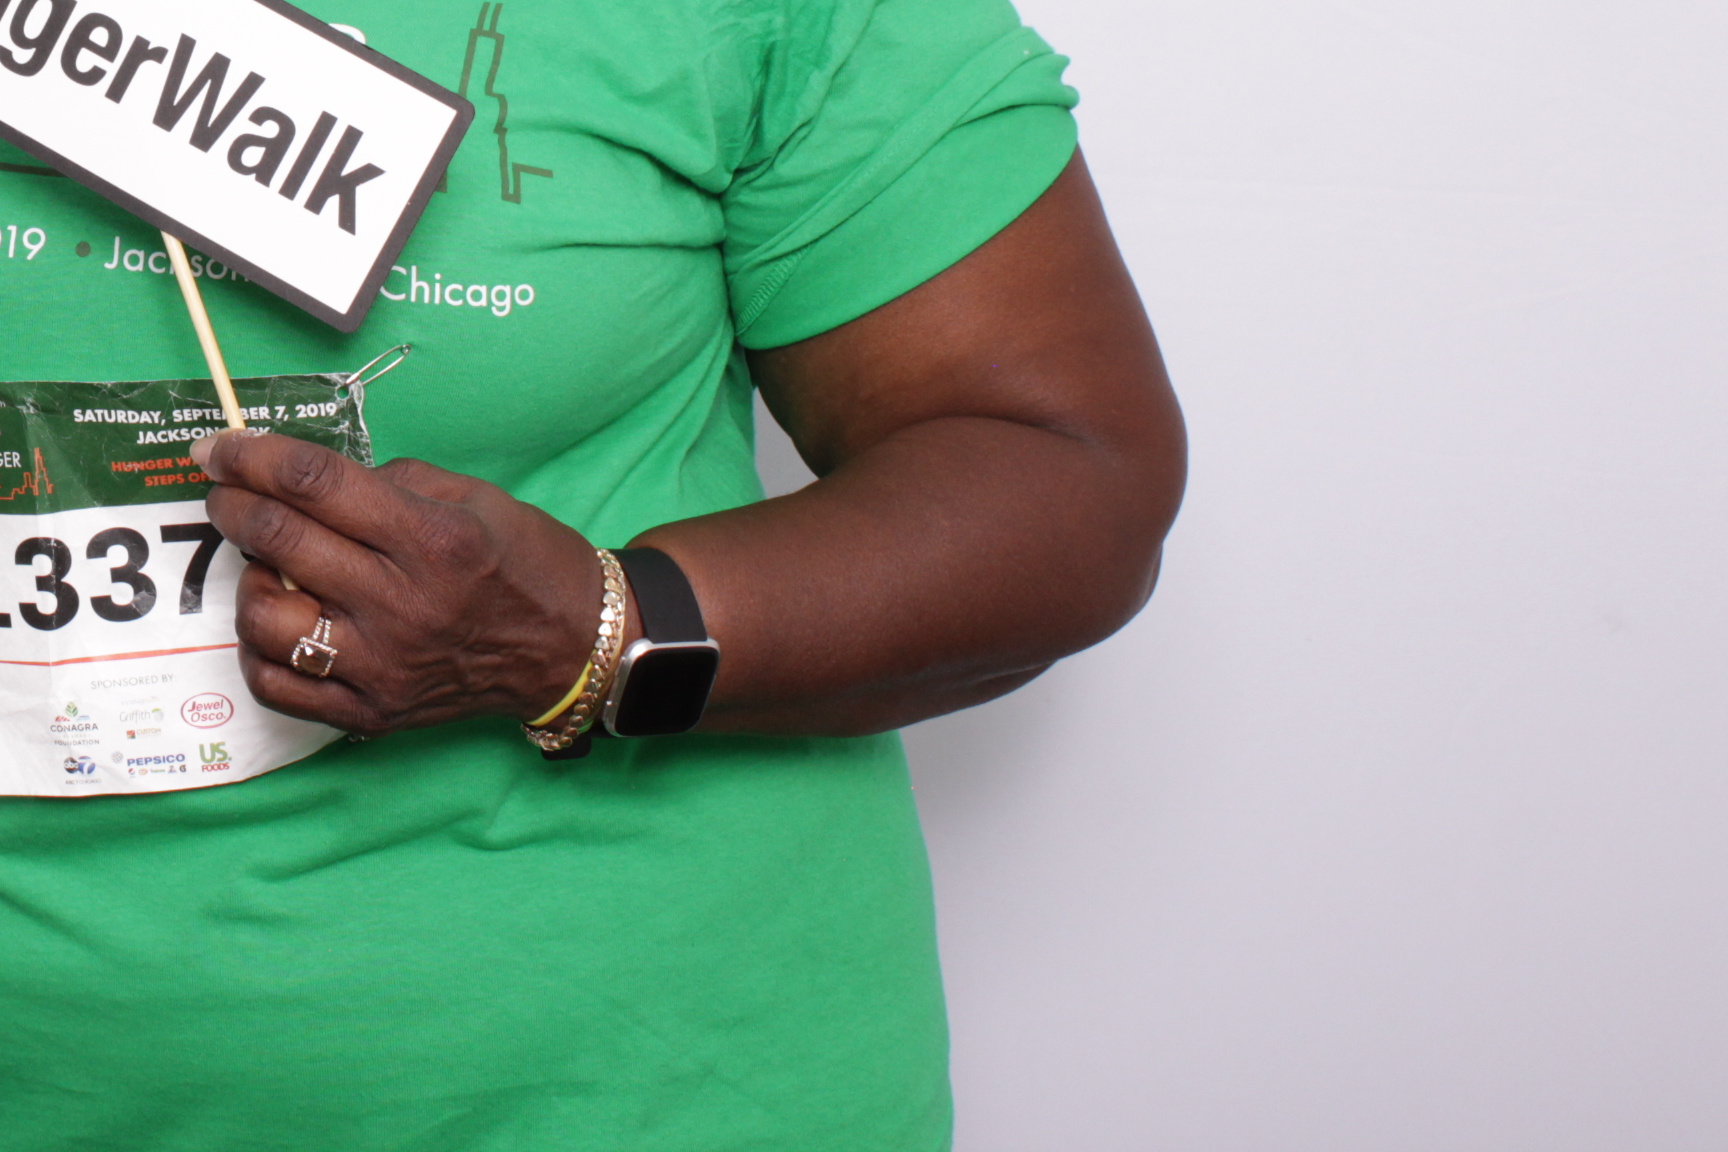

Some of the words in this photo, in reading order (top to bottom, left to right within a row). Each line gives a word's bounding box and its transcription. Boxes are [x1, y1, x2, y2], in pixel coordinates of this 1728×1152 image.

[104, 236, 251, 283] Jacso
[379, 265, 535, 317] Chicago
[73, 408, 166, 426] SATURDAY,
[172, 406, 271, 423] SEPTEBER
[274, 405, 290, 421] 7,
[295, 402, 337, 419] 2019
[111, 457, 174, 473] HUNGER
[144, 474, 186, 487] STEPS
[188, 471, 214, 485] OF
[90, 675, 159, 690] SPONSORED
[188, 699, 224, 712] Jewel
[50, 723, 99, 733] CONAGRA
[127, 753, 186, 766] PEPSICO
[201, 762, 230, 773] FOODS
